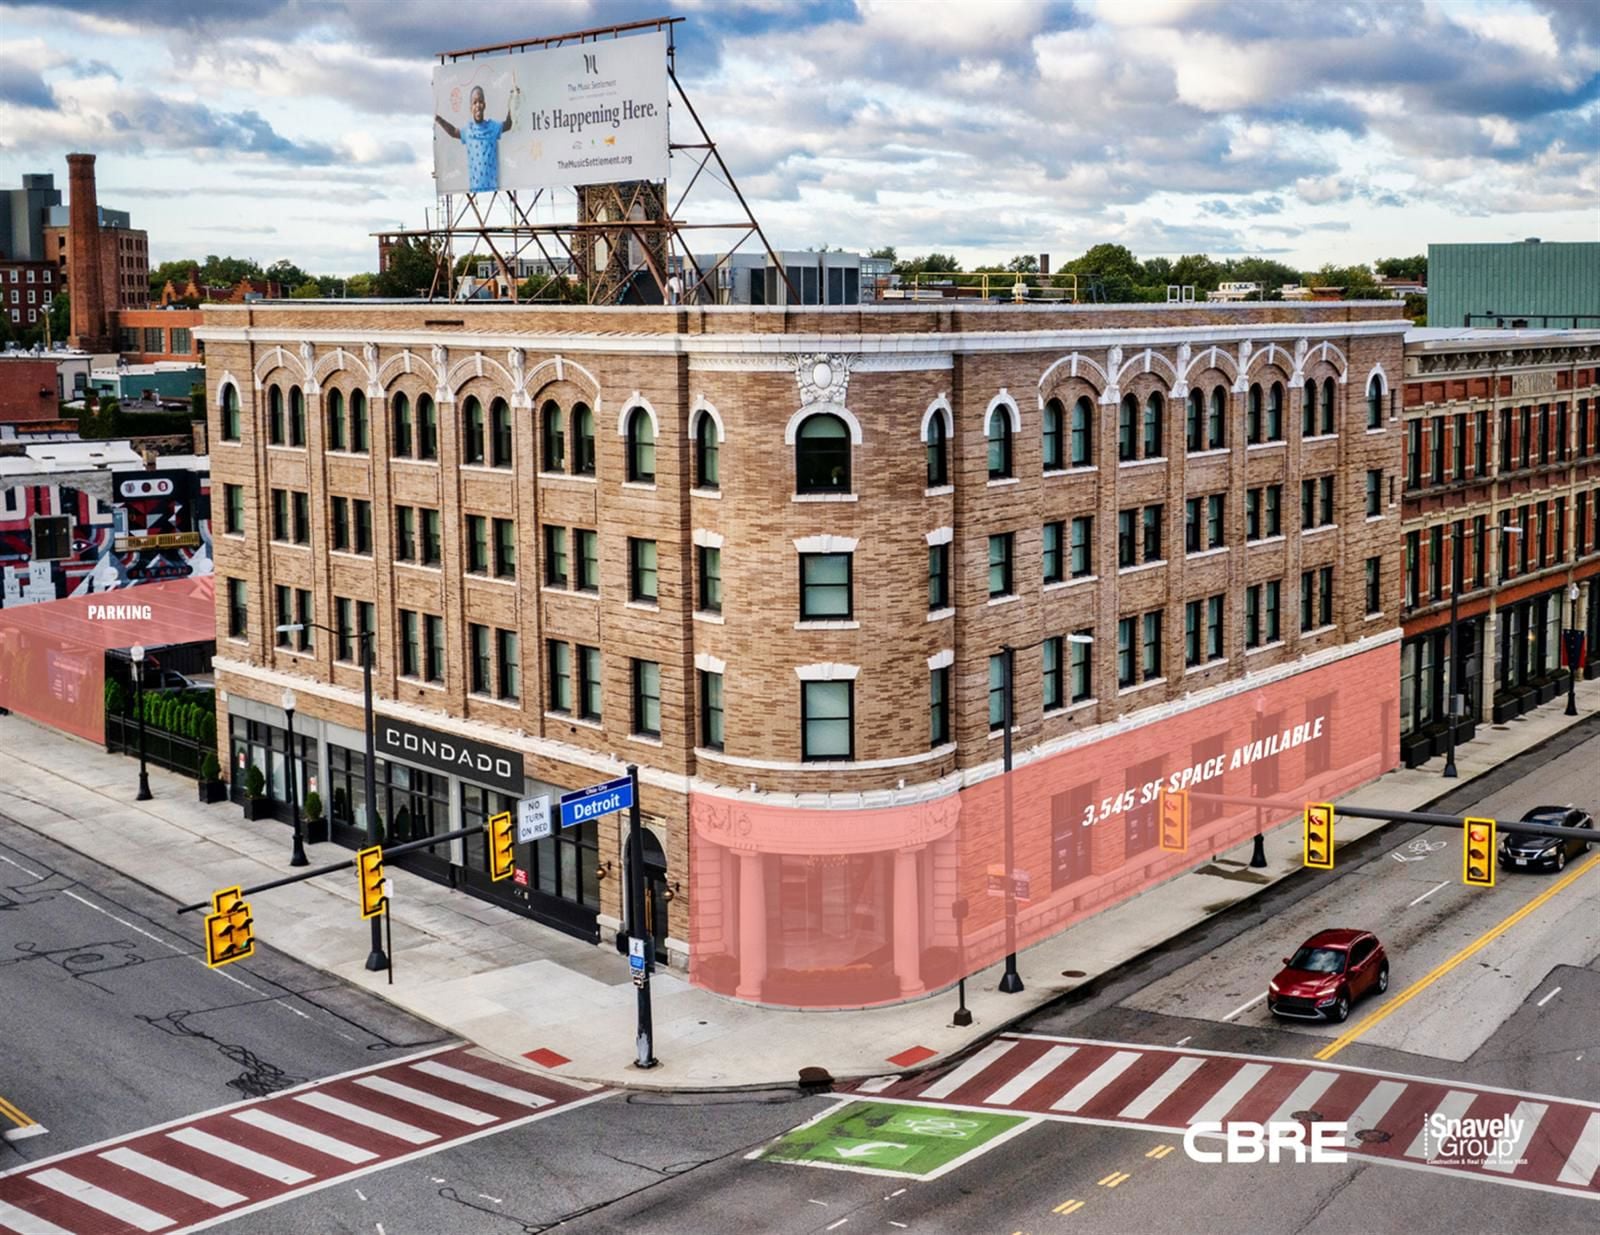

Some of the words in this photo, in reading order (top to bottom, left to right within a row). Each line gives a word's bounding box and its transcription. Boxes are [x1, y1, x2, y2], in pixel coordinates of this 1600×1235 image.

[532, 110, 551, 131] It's
[552, 104, 621, 133] Happening
[622, 100, 658, 120] Here.
[557, 155, 633, 169] TheMusicSettlement.org
[386, 728, 512, 778] CONDADO
[528, 801, 540, 811] NO
[574, 793, 620, 820] Detroit
[525, 812, 544, 824] TURN
[521, 826, 532, 837] ON
[534, 823, 548, 833] RED
